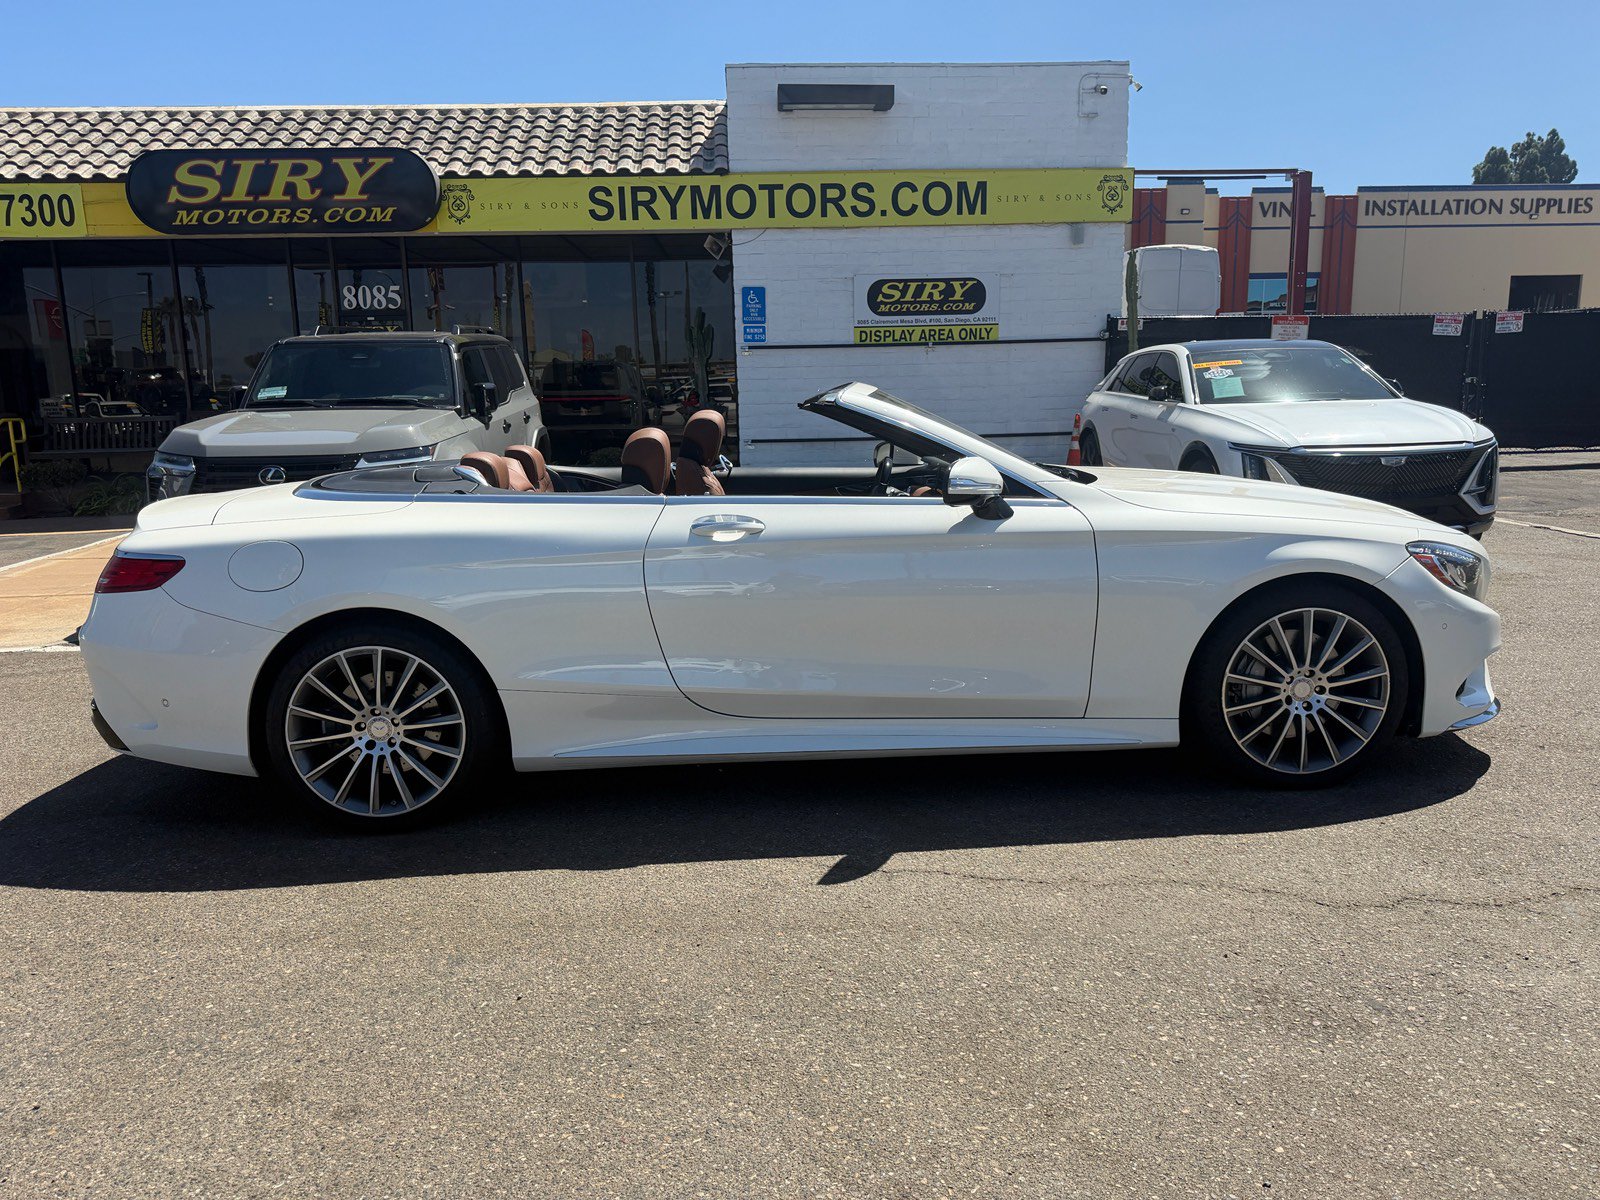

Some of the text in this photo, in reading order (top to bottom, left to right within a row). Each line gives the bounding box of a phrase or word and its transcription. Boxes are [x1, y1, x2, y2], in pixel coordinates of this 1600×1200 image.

[168, 157, 394, 204] SIRY
[0, 193, 76, 227] 7300
[480, 180, 1092, 221] SIRY & SONS SIRYMOTORS.COM SIRY & SONS
[1258, 201, 1317, 218] VIN
[1364, 197, 1594, 216] INSTALLATION SUPPLIES
[172, 207, 398, 226] MOTORS.COM
[342, 285, 402, 310] 8085
[876, 281, 977, 302] SIRY
[877, 302, 977, 313] MOTORS.COM
[859, 327, 993, 343] DISPLAY AREA ONLY
